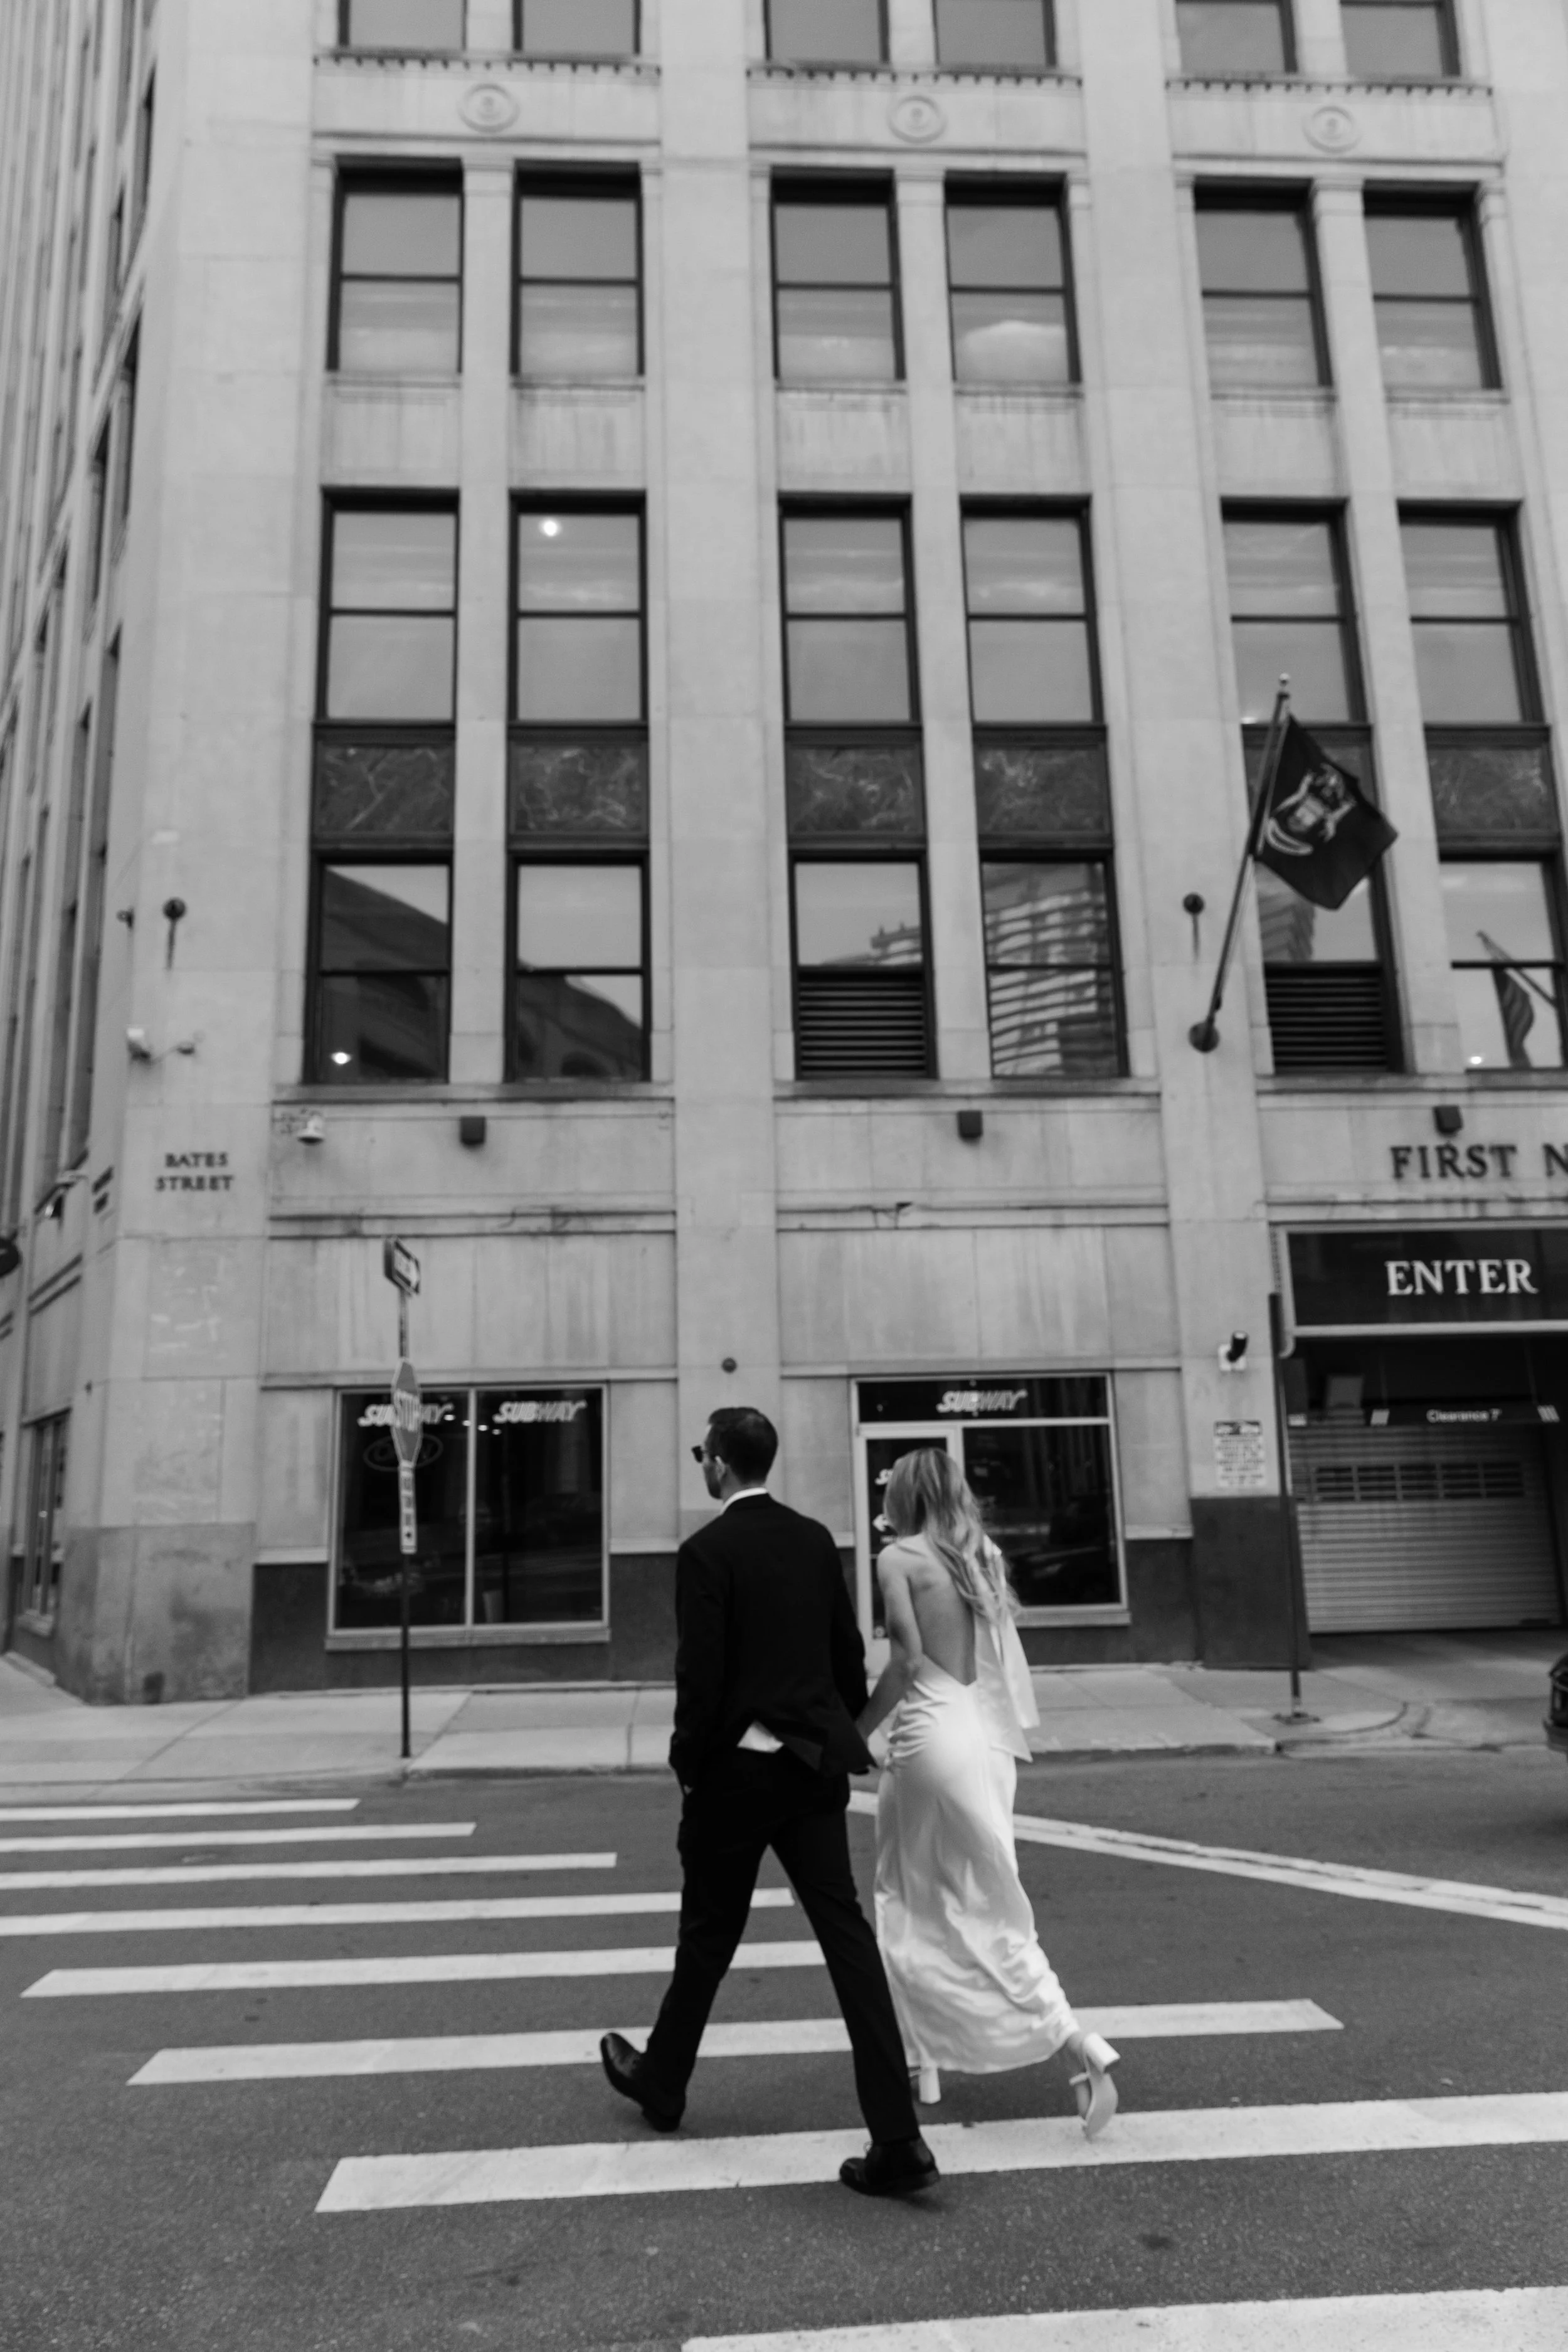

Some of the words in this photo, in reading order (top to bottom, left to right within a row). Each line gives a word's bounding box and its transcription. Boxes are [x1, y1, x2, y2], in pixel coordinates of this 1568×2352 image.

[165, 1152, 228, 1168] BATES
[1390, 1143, 1517, 1179] FIRST
[156, 1174, 234, 1192] STREET
[1384, 1258, 1539, 1296] ENTER
[492, 1399, 588, 1424] SUBWAY
[936, 1388, 1029, 1412] SUBWAY
[1426, 1408, 1490, 1422] Clearance
